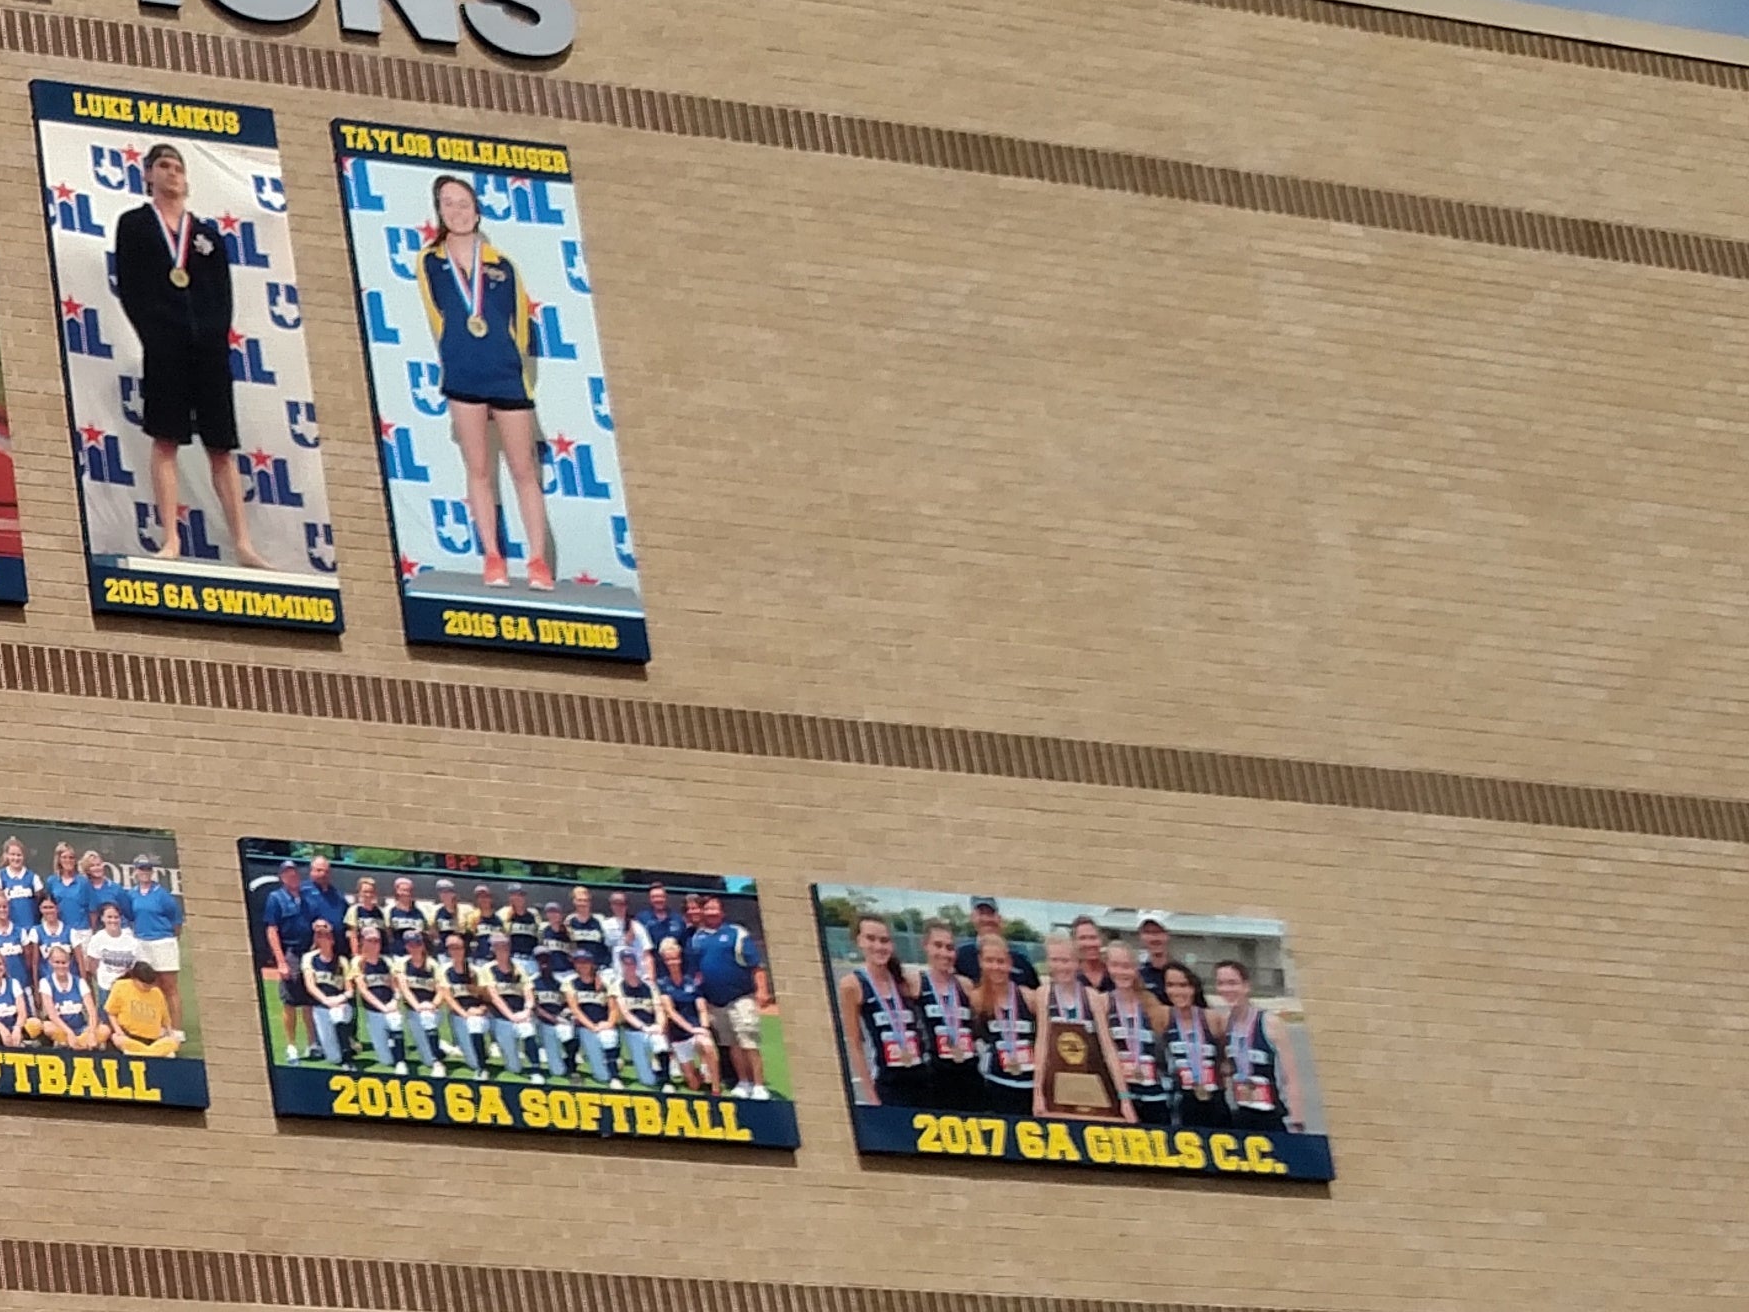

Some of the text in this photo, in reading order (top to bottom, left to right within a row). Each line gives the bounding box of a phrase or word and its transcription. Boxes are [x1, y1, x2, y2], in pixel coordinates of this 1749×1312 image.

[74, 93, 240, 135] LUKE MANKUS
[342, 125, 433, 157] TAYLOR
[105, 578, 335, 623] 2015 6A SWIMMING
[444, 611, 618, 649] 2016 6A DIVING
[330, 1075, 751, 1141] 2016 6A SOFTBALL
[914, 1114, 1286, 1174] 2017 6A GIRLS C.C.
